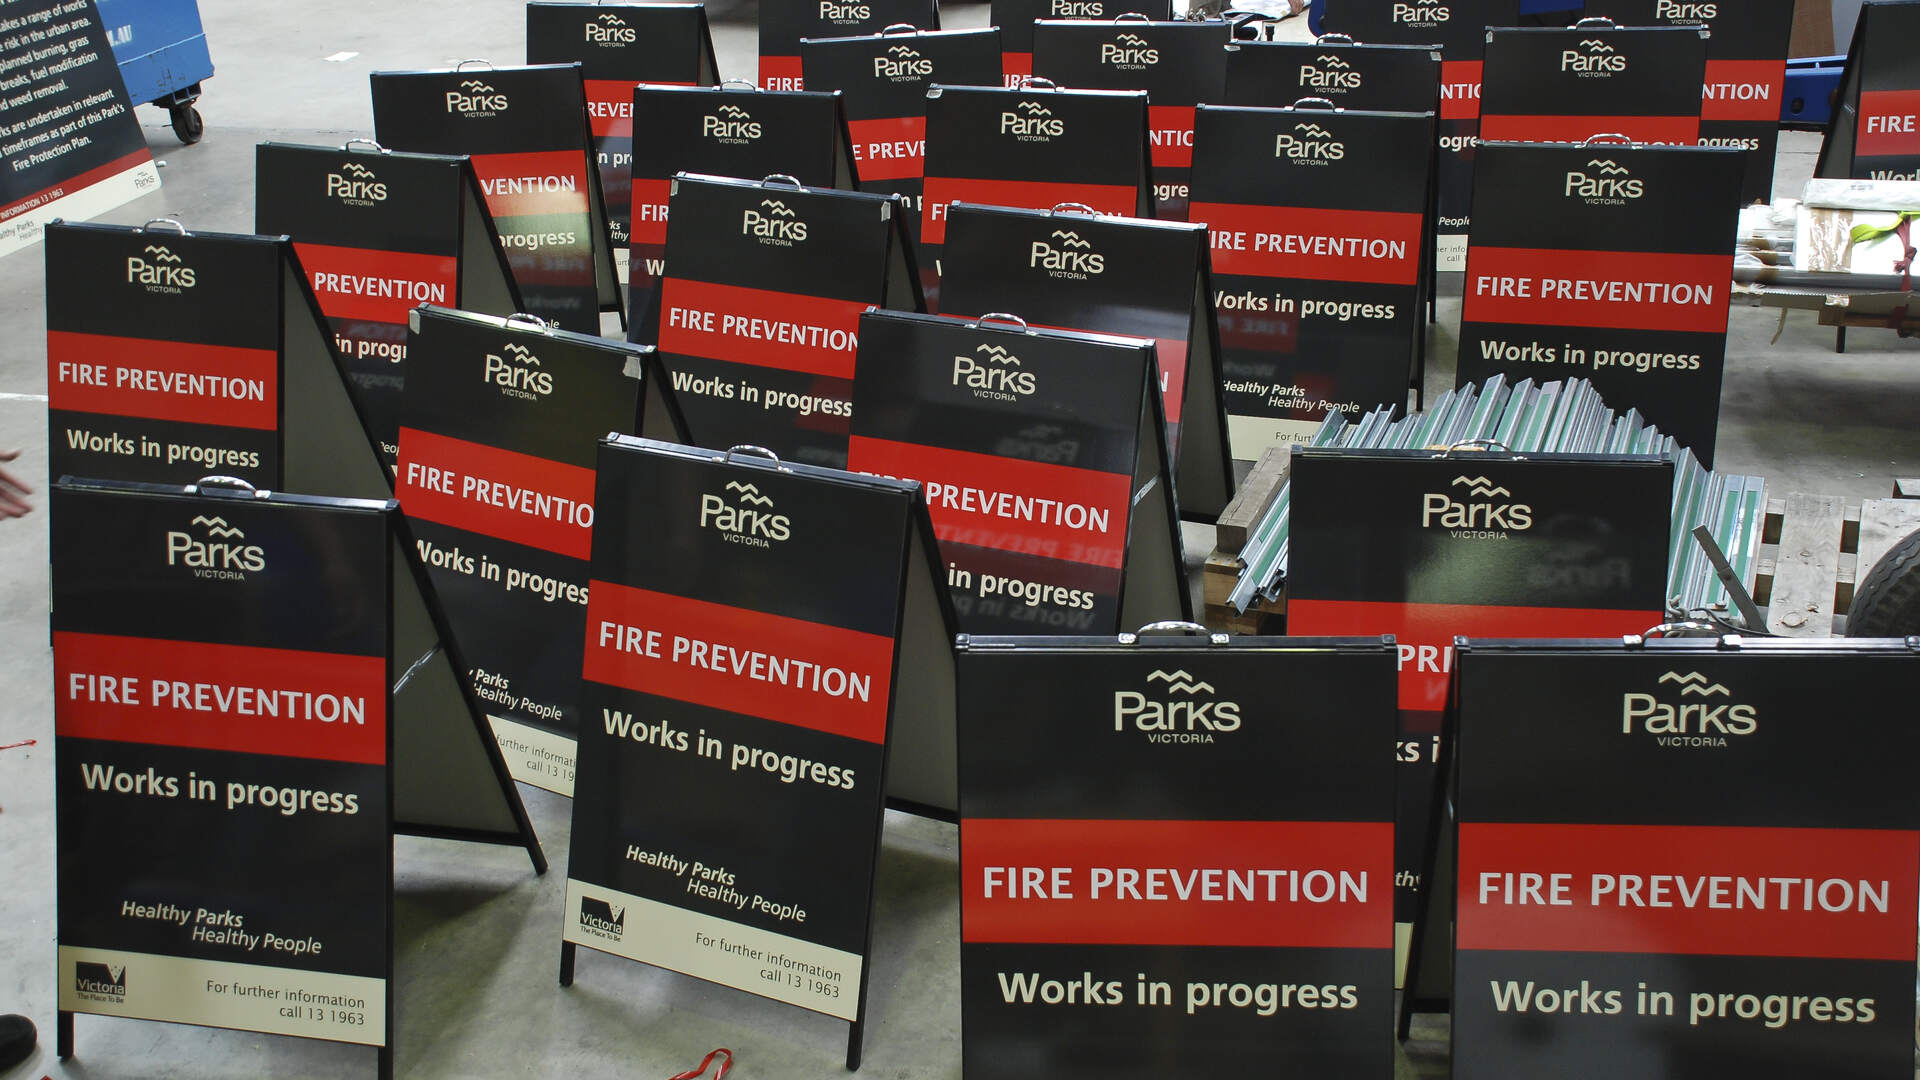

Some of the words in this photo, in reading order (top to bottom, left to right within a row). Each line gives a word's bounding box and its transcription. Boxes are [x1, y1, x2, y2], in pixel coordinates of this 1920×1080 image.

[20, 16, 27, 26] a
[27, 9, 52, 23] range
[52, 3, 62, 16] of
[62, 0, 87, 13] works
[820, 1, 870, 20] Parks
[1051, 0, 1103, 16] Parks
[1393, 4, 1449, 23] Parks
[1656, 0, 1717, 19] Parks
[4, 37, 20, 50] risk
[20, 35, 30, 46] in
[30, 30, 46, 42] the
[46, 24, 70, 37] urban
[585, 23, 636, 42] Parks
[0, 52, 33, 73] planned
[68, 36, 89, 52] grass
[31, 66, 48, 80] fuel
[48, 52, 98, 75] modification
[874, 57, 933, 77] Parks
[1101, 44, 1158, 65] Parks
[1561, 50, 1626, 72] Parks
[767, 77, 803, 91] FIRE
[1300, 65, 1361, 88] Parks
[9, 91, 33, 107] weed
[11, 121, 26, 133] are
[26, 105, 73, 128] undertaken
[73, 100, 83, 112] in
[83, 88, 114, 108] relevant
[446, 92, 508, 113] Parks
[464, 110, 496, 118] VICTORIA
[703, 115, 762, 139] Parks
[1001, 112, 1064, 137] Parks
[1867, 115, 1916, 133] FIRE
[2, 132, 50, 156] timeframes
[50, 129, 59, 139] as
[60, 123, 78, 138] part
[78, 118, 87, 130] of
[86, 112, 102, 126] this
[102, 103, 125, 120] Park's
[12, 156, 31, 172] Fire
[30, 143, 72, 166] Protection
[71, 135, 92, 150] Plan.
[1275, 134, 1344, 160] Parks
[134, 174, 155, 189] Parks
[327, 173, 387, 200] Parks
[1565, 172, 1644, 198] Parks
[343, 199, 375, 207] VICTORIA
[743, 210, 808, 241] Parks
[759, 237, 793, 247] VICTORIA
[1254, 233, 1406, 260] PREVENTION
[1030, 241, 1104, 274] Parks
[127, 256, 196, 288] Parks
[1049, 270, 1087, 281] VICTORIA
[146, 285, 182, 294] VICTORIA
[314, 272, 445, 303] PREVENTION
[1476, 276, 1531, 298] FIRE
[1541, 279, 1713, 305] PREVENTION
[1275, 293, 1294, 313] in
[1300, 296, 1395, 321] progress
[669, 307, 715, 333] FIRE
[722, 314, 858, 352] PREVENTION
[1480, 340, 1556, 363] Works
[1563, 343, 1585, 364] in
[1593, 350, 1700, 373] progress
[59, 362, 108, 387] FIRE
[116, 367, 264, 401] PREVENTION
[484, 354, 553, 395] Parks
[953, 357, 1036, 395] Parks
[501, 388, 538, 401] VICTORIA
[671, 371, 734, 398] Works
[740, 381, 759, 402] in
[764, 388, 853, 418] progress
[973, 389, 1017, 402] VICTORIA
[1268, 396, 1316, 412] Healthy
[1272, 384, 1306, 397] Parks
[67, 429, 135, 456] Works
[142, 436, 161, 458] in
[168, 441, 260, 468] progress
[1275, 432, 1290, 441] For
[407, 462, 454, 496] FIRE
[462, 475, 594, 528] PREVENTIO
[926, 481, 1109, 533] PREVENTION
[700, 493, 791, 541] Parks
[1422, 493, 1532, 530] Parks
[722, 532, 770, 549] VICTORIA
[1450, 530, 1508, 540] VICTORIA
[168, 531, 266, 572] Parks
[194, 569, 245, 581] VICTORIA
[480, 555, 500, 582] in
[948, 562, 971, 589] in
[980, 574, 1095, 610] progress
[599, 620, 662, 660] FIRE
[672, 636, 871, 703] PREVENTION
[475, 668, 509, 690] Parks
[70, 673, 140, 705] FIRE
[152, 679, 365, 725] PREVENTION
[521, 697, 562, 720] People
[1114, 690, 1241, 732] Parks
[1622, 693, 1757, 735] Parks
[603, 708, 689, 752] Works
[697, 729, 723, 759] in
[731, 738, 855, 790] progress
[1148, 733, 1214, 744] VICTORIA
[1657, 736, 1728, 748] VICTORIA
[526, 760, 543, 773] call
[547, 765, 558, 777] 13
[82, 764, 178, 797] Works
[190, 772, 216, 801] in
[227, 779, 359, 816] progress
[625, 845, 689, 876] Healthy
[692, 862, 736, 885] Parks
[983, 866, 1073, 899] FIRE
[1091, 867, 1367, 903] PREVENTION
[1479, 872, 1572, 906] FIRE
[1591, 873, 1889, 913] PREVENTION
[686, 877, 749, 910] Healthy
[752, 895, 806, 922] People
[122, 901, 191, 926] Healthy
[196, 907, 244, 928] Parks
[581, 912, 623, 934] Victoria
[192, 926, 260, 952] Healthy
[263, 934, 322, 956] People
[695, 932, 716, 947] For
[719, 936, 763, 961] further
[766, 951, 842, 983] information
[77, 978, 125, 994] Victoria
[206, 980, 227, 994] For
[233, 981, 280, 1000] further
[285, 988, 365, 1010] information
[760, 968, 782, 984] call
[786, 973, 801, 989] 13
[807, 976, 840, 999] 1963
[998, 971, 1123, 1005] Works
[1137, 973, 1172, 1006] in
[1187, 980, 1358, 1016] progress
[279, 1005, 302, 1020] call
[307, 1007, 324, 1022] 13
[331, 1010, 365, 1026] 1963
[1490, 980, 1622, 1015] Works
[1637, 983, 1674, 1016] in
[1689, 991, 1876, 1028] progress
